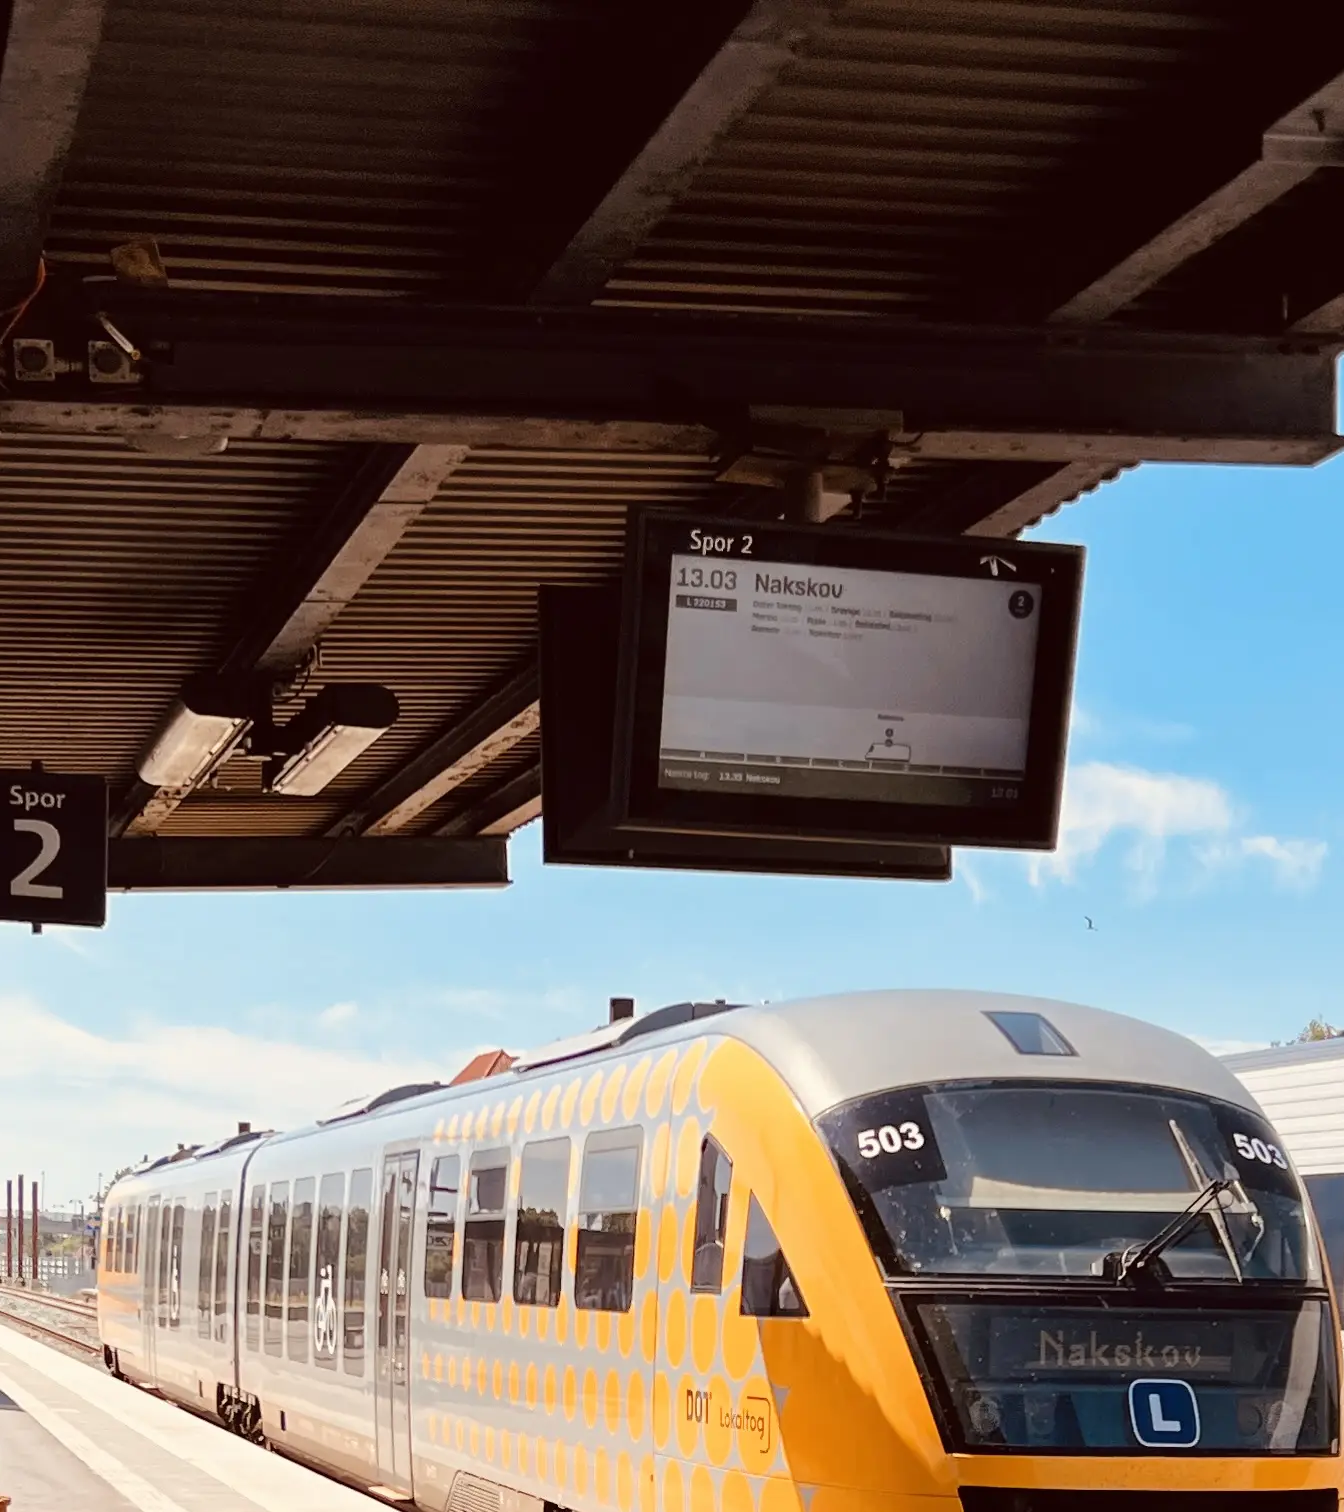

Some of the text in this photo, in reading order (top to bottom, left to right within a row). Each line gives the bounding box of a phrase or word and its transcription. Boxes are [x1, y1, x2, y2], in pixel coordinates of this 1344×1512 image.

[689, 528, 754, 556] Spor 2
[676, 566, 844, 599] 13.03 Nakskov
[9, 784, 66, 812] Spor
[10, 818, 64, 899] 2
[857, 1120, 926, 1159] 503
[1232, 1131, 1290, 1170] 503
[1039, 1329, 1202, 1368] Nakskov
[719, 1407, 765, 1441] Lokaltog
[1148, 1393, 1182, 1432] L
